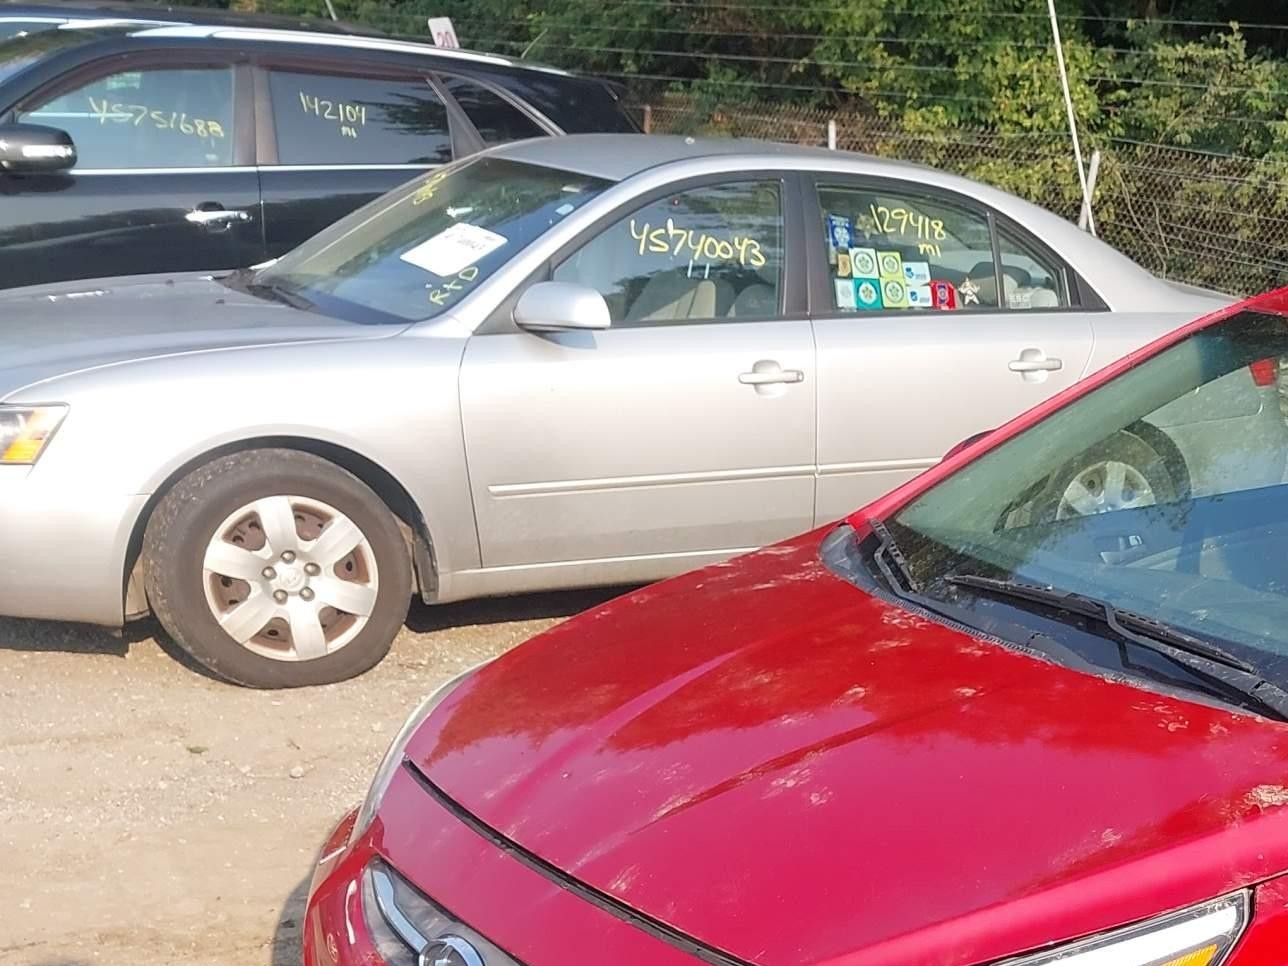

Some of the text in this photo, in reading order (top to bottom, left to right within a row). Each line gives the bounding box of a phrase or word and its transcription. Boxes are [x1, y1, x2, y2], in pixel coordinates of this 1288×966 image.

[299, 91, 366, 126] 142104
[870, 204, 946, 241] 129418
[629, 218, 767, 267] 45740043
